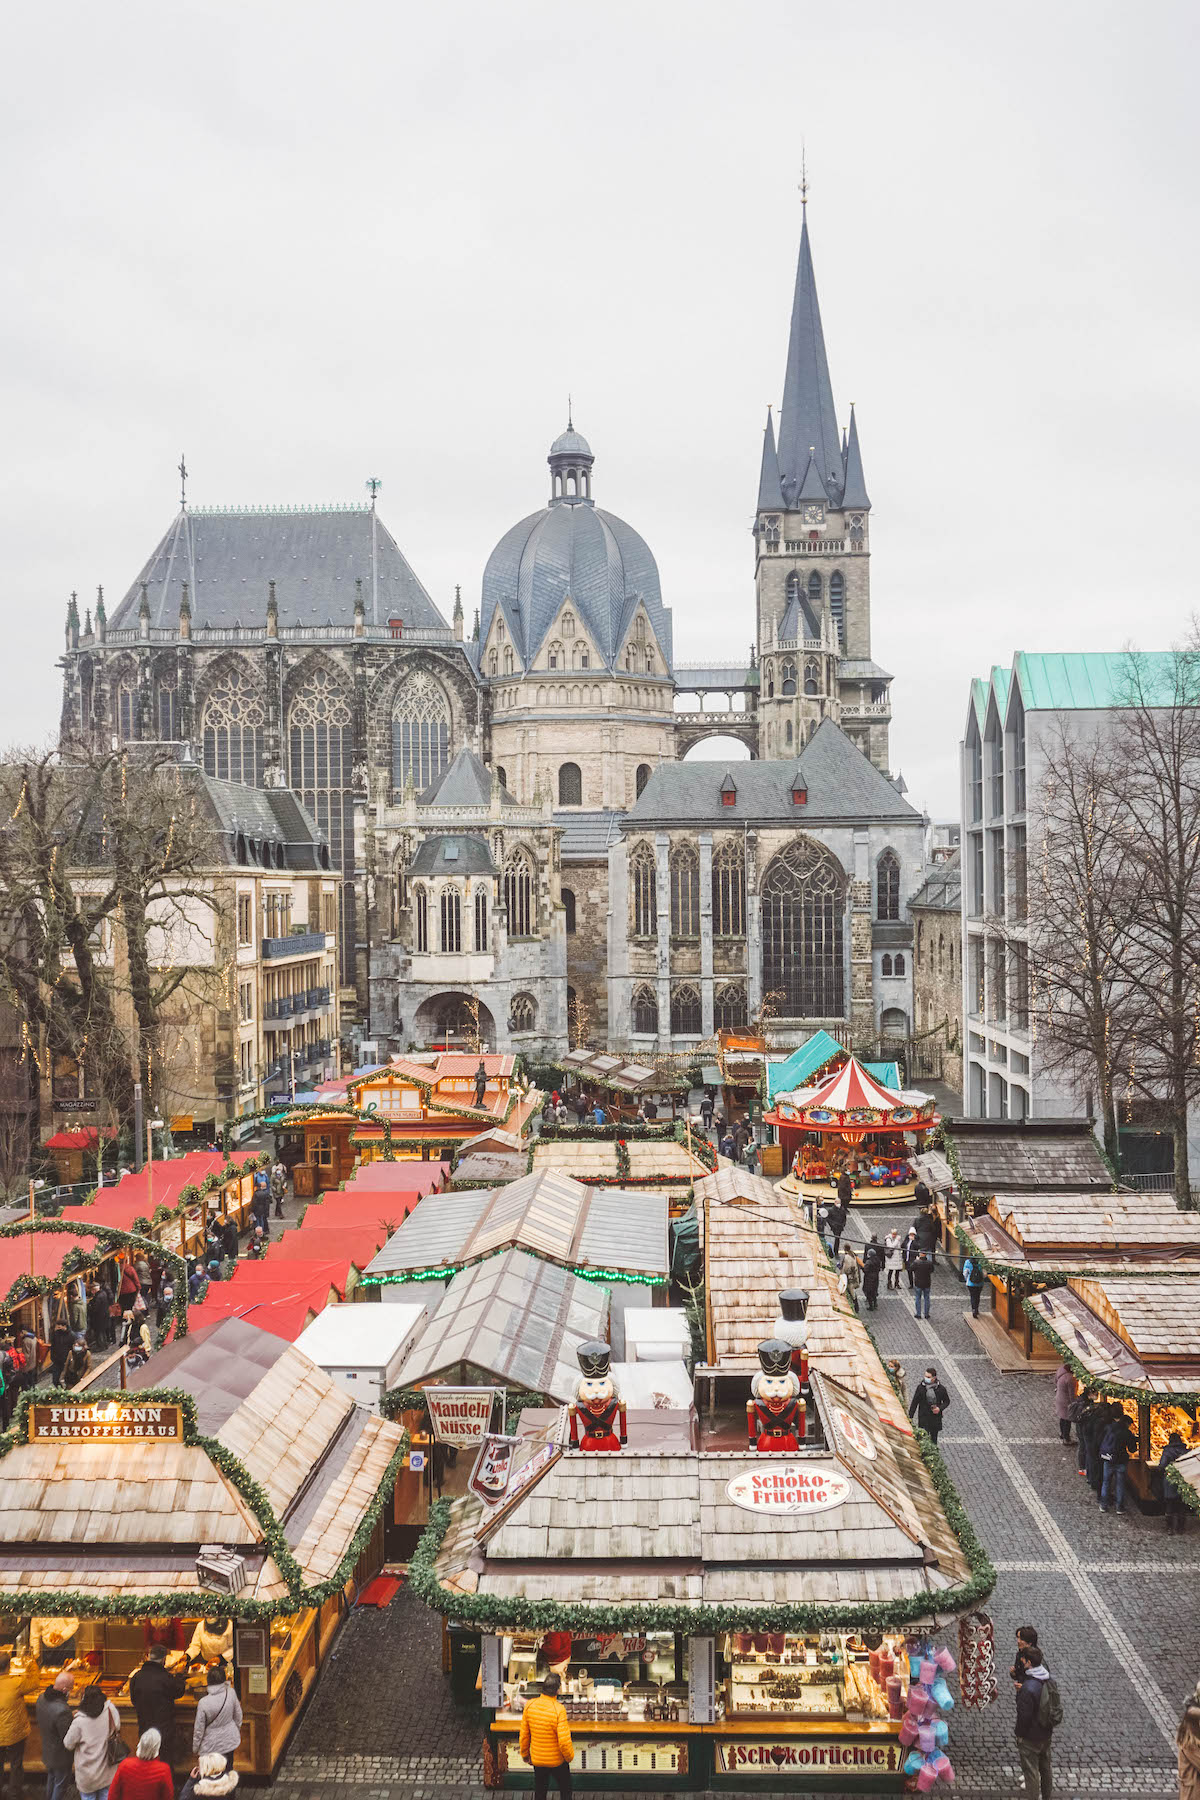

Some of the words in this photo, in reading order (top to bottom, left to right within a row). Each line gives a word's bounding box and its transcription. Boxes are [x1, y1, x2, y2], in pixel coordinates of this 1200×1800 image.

[431, 1401, 490, 1419] Mandeln
[38, 1425, 176, 1437] KARTOFFELHAUS
[440, 1420, 481, 1436] Nüsse
[751, 1474, 831, 1489] Schoko-
[753, 1489, 828, 1504] Früchte
